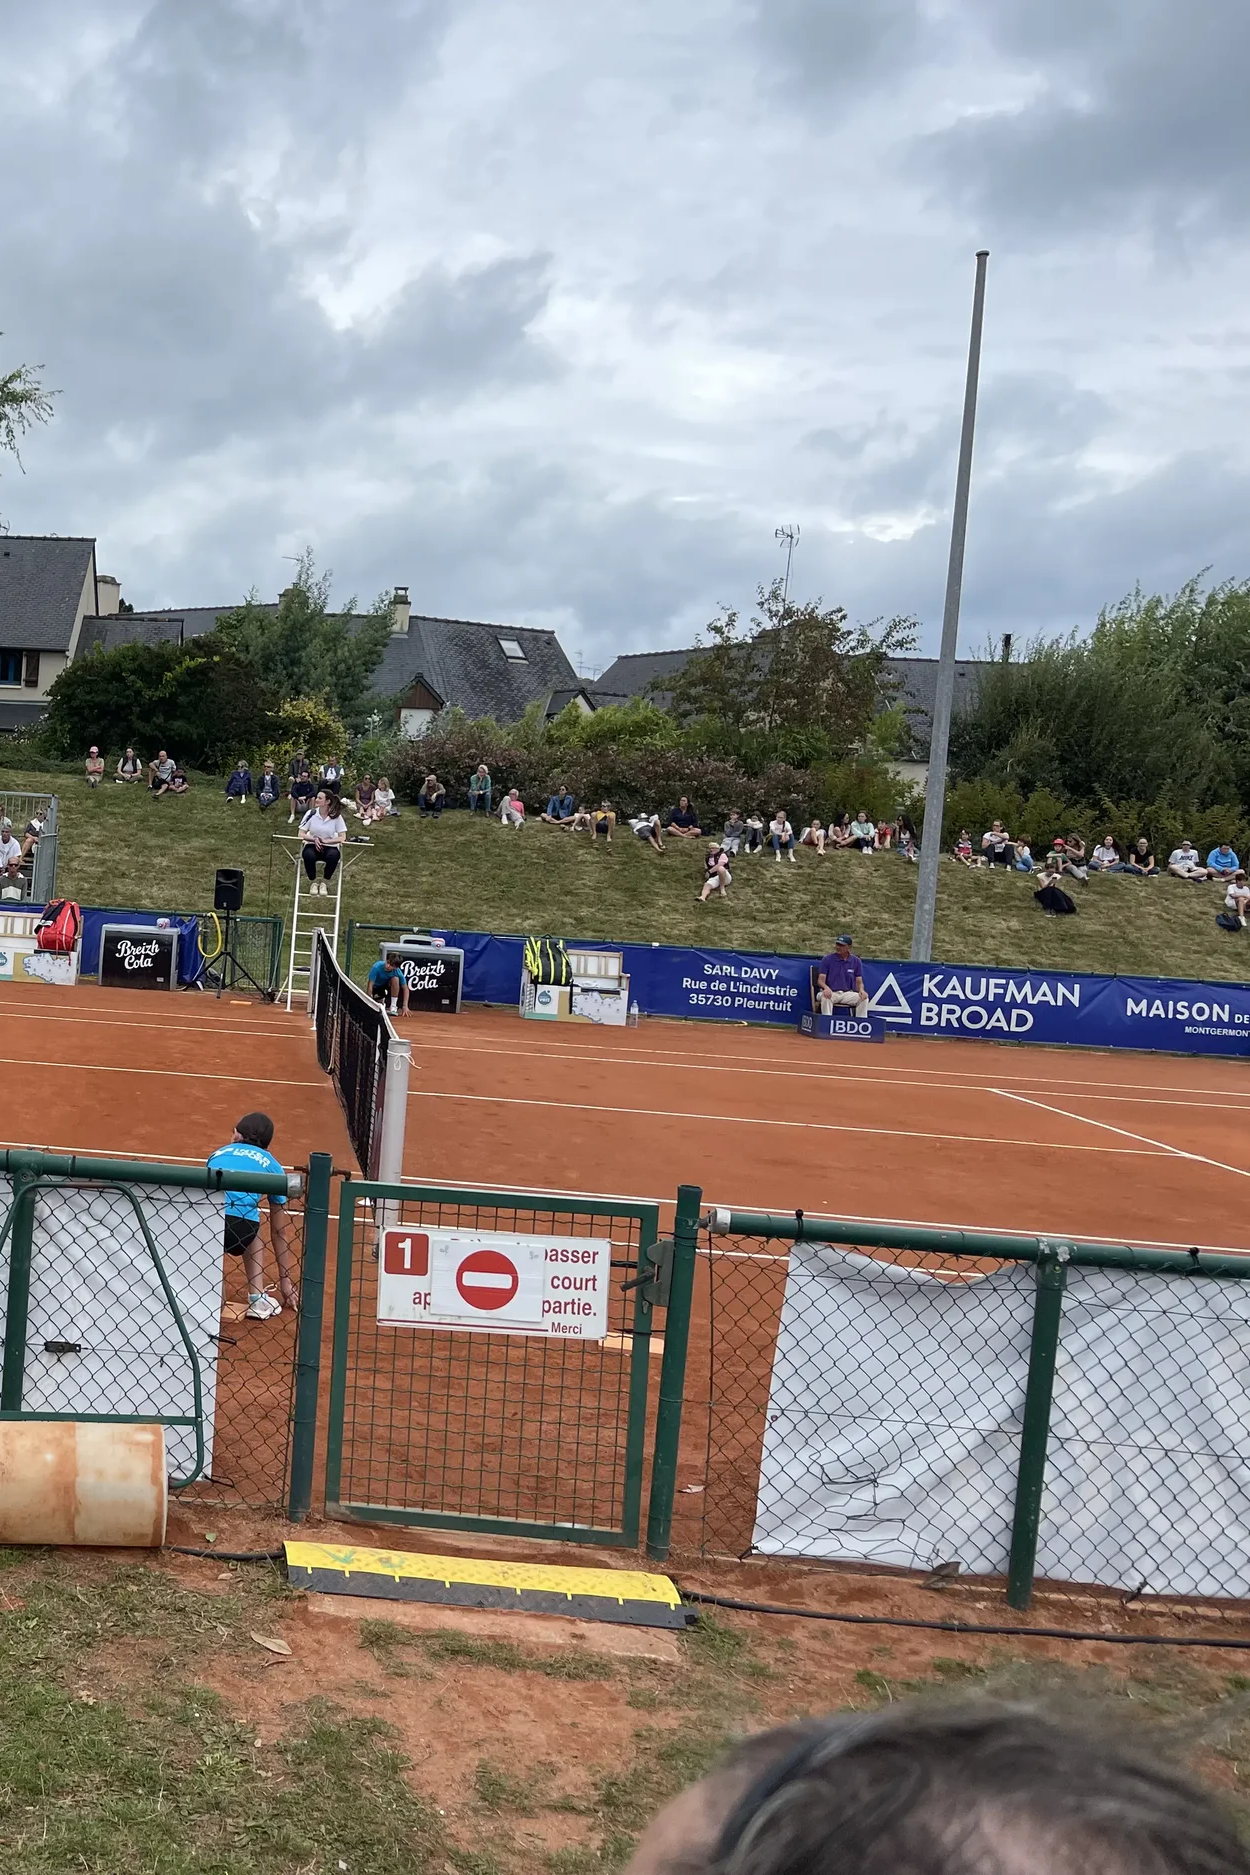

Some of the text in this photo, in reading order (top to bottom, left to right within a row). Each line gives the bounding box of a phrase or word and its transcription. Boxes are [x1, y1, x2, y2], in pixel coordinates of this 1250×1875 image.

[115, 939, 160, 957] Breizh
[124, 954, 153, 970] Cola
[400, 959, 446, 978] Breizh
[703, 963, 779, 980] SARL DAVY
[408, 975, 439, 991] Cola
[682, 977, 798, 997] Rue de L'industrie
[922, 974, 1080, 1007] KAUFMAN
[689, 993, 792, 1012] 35730 Pleurtuit
[1126, 997, 1230, 1022] MAISON
[920, 1002, 1034, 1032] BROAD
[835, 1020, 872, 1035] BDO
[398, 1237, 412, 1269] 1
[551, 1274, 598, 1292] court
[542, 1297, 597, 1318] partie.
[551, 1321, 583, 1335] Merci
